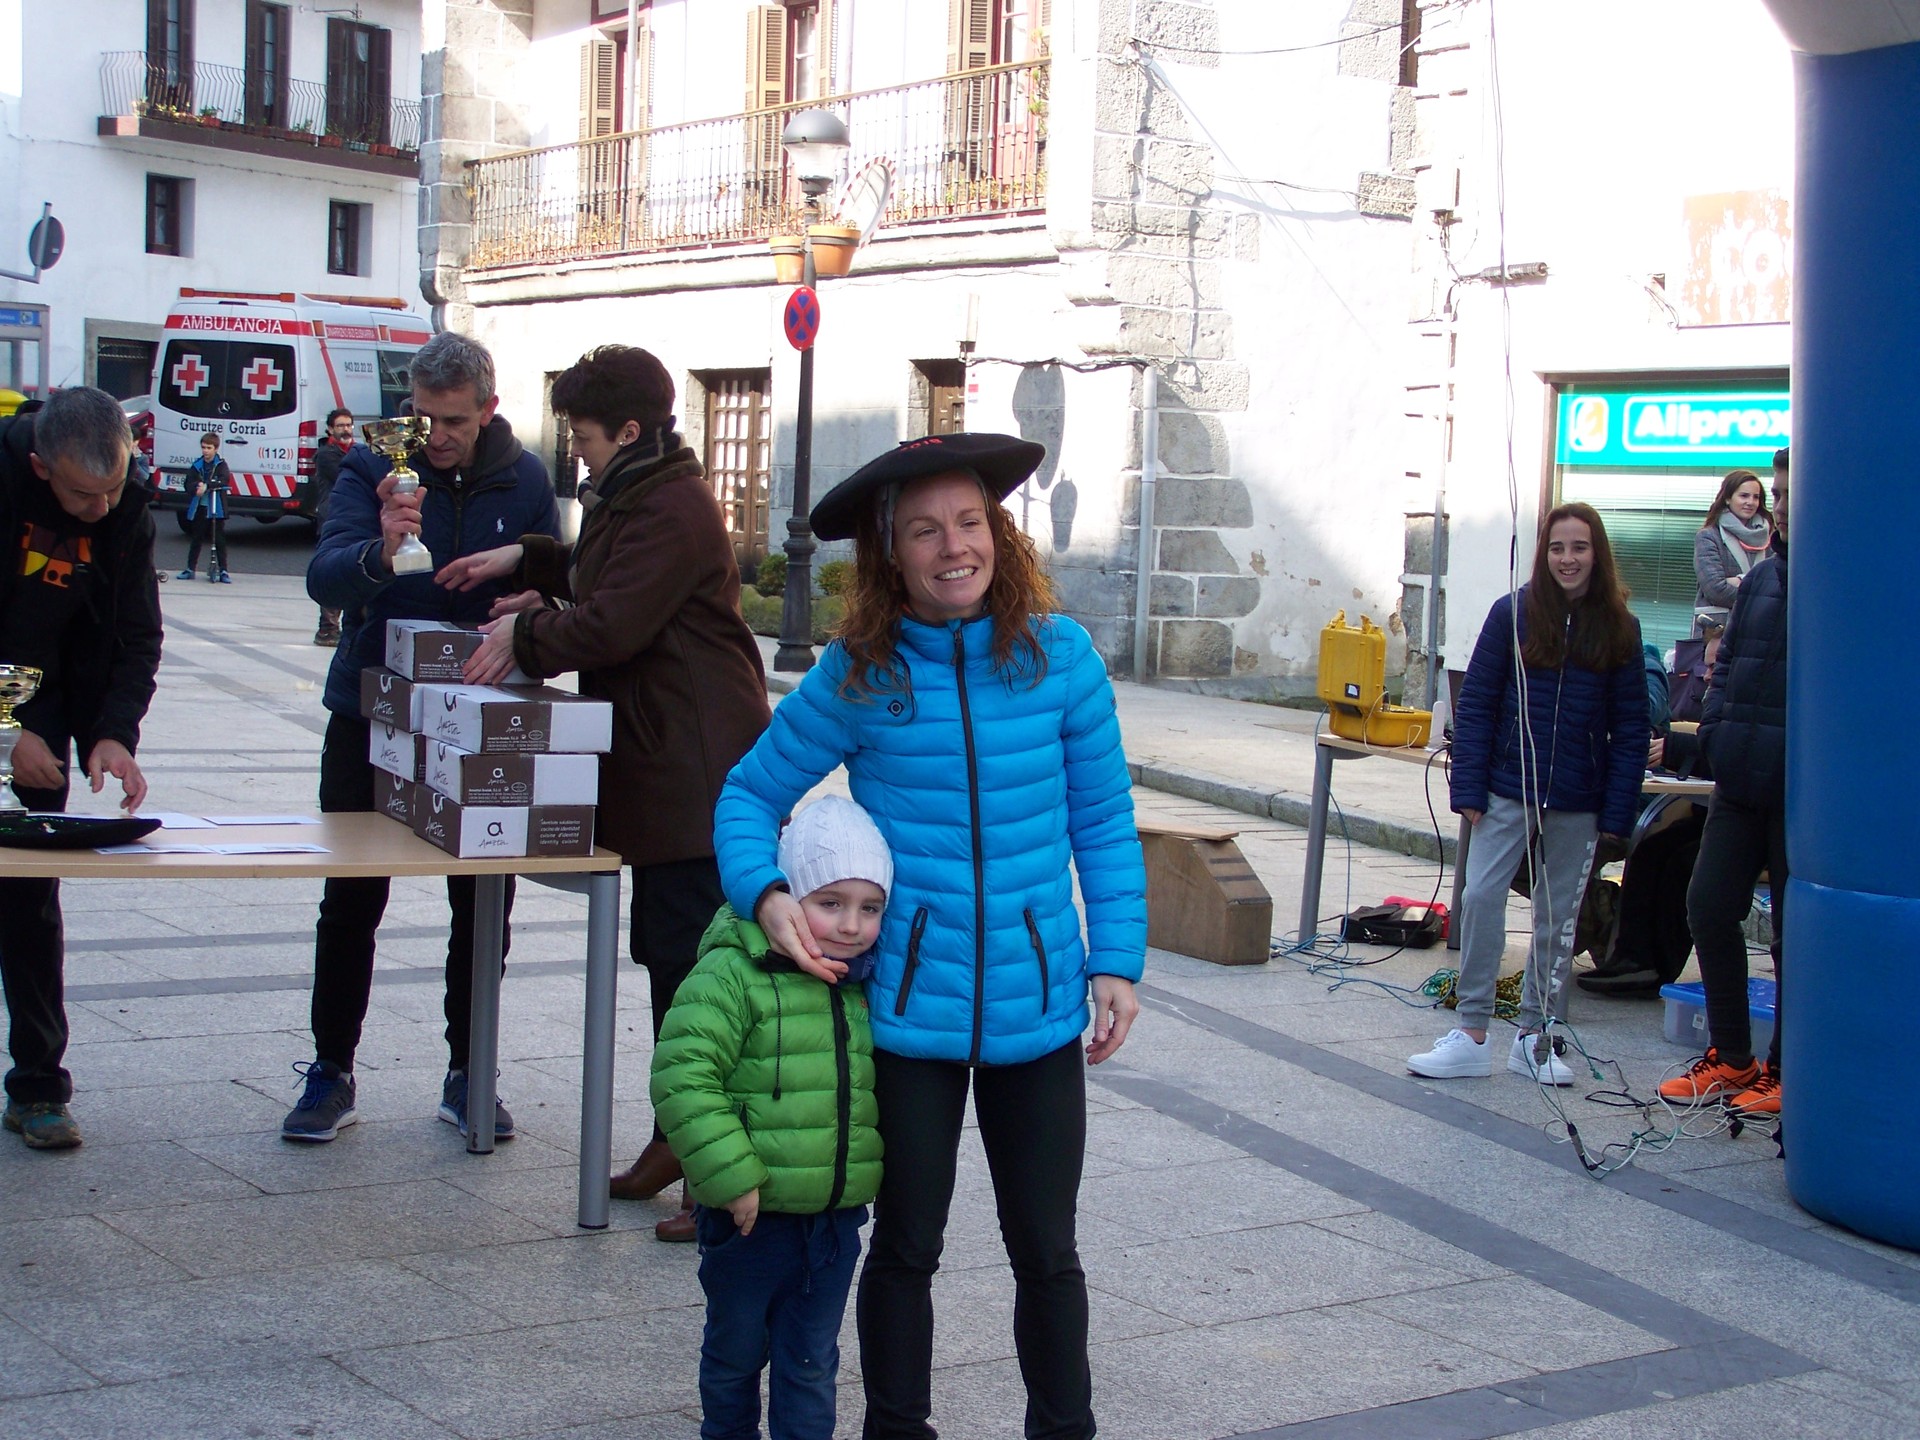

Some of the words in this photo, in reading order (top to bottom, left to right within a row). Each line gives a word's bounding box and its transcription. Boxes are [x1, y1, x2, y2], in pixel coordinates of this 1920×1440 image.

[181, 315, 283, 333] AMBULANCIA
[180, 418, 223, 434] Gurutze
[229, 421, 266, 436] Gorria
